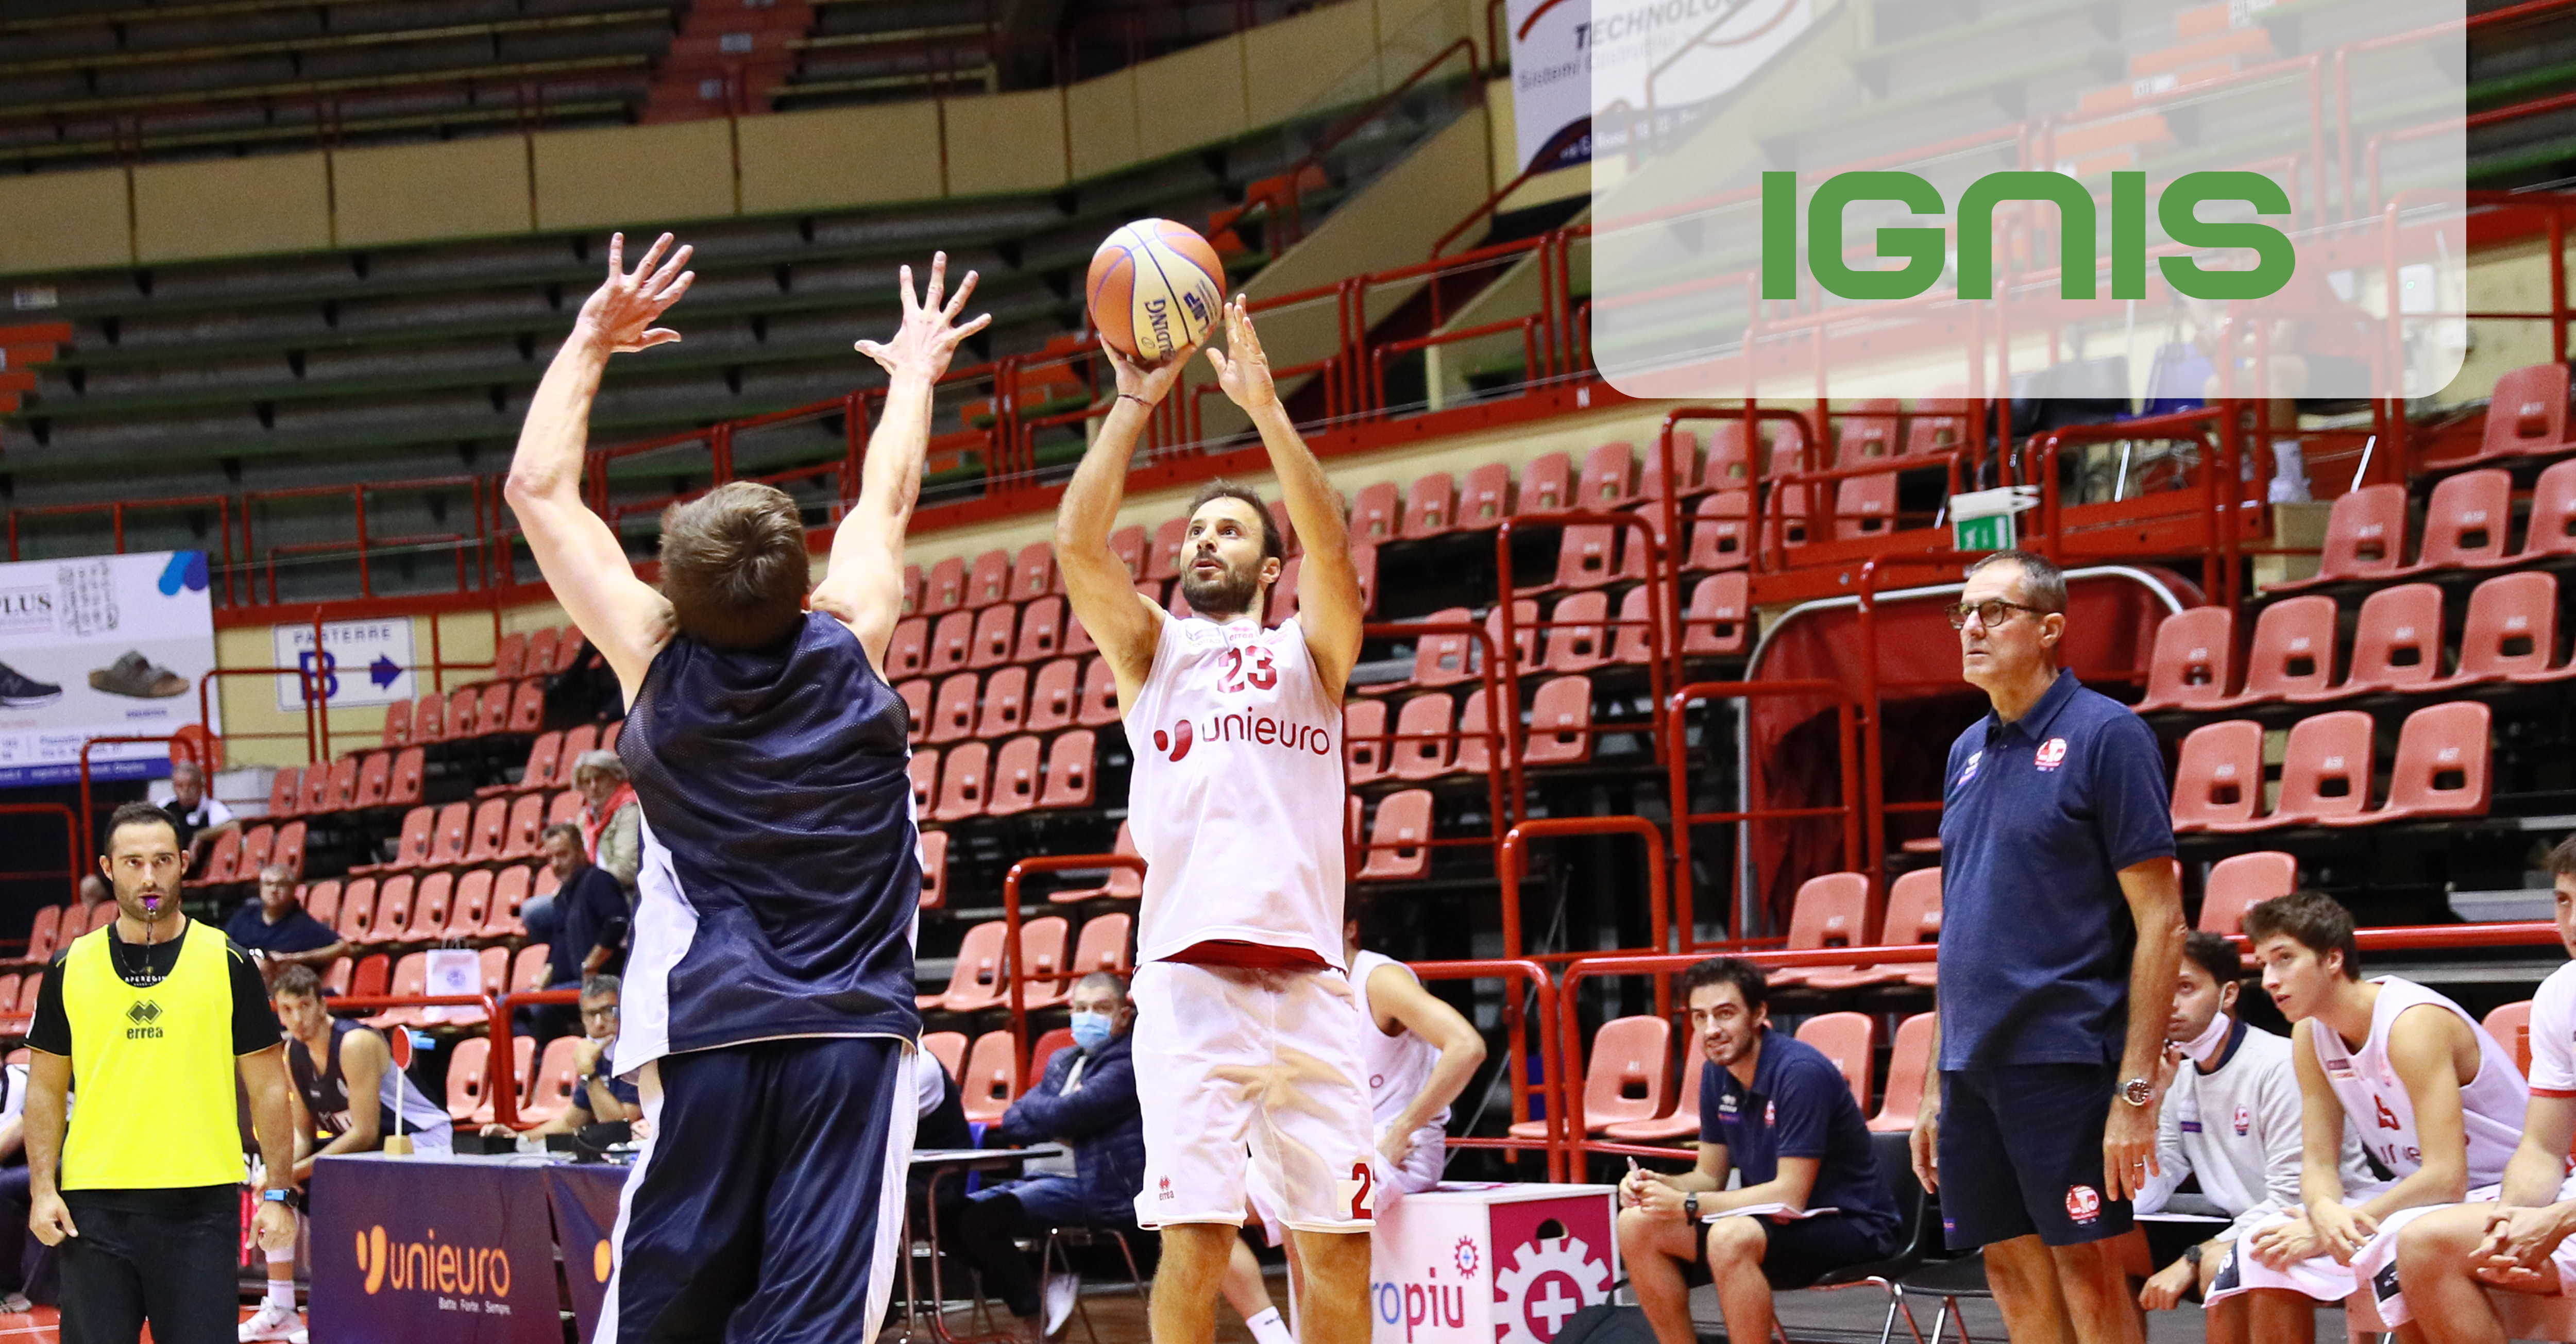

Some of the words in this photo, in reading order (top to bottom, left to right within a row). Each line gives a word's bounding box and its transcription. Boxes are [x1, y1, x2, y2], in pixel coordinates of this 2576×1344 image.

[0, 592, 52, 614] LUS
[299, 651, 338, 700] B
[1217, 645, 1277, 693] 23
[1202, 706, 1330, 755] unieuro
[1351, 1163, 1375, 1219] 2
[390, 1228, 511, 1297] unieuro
[1372, 1267, 1465, 1343] opiu
